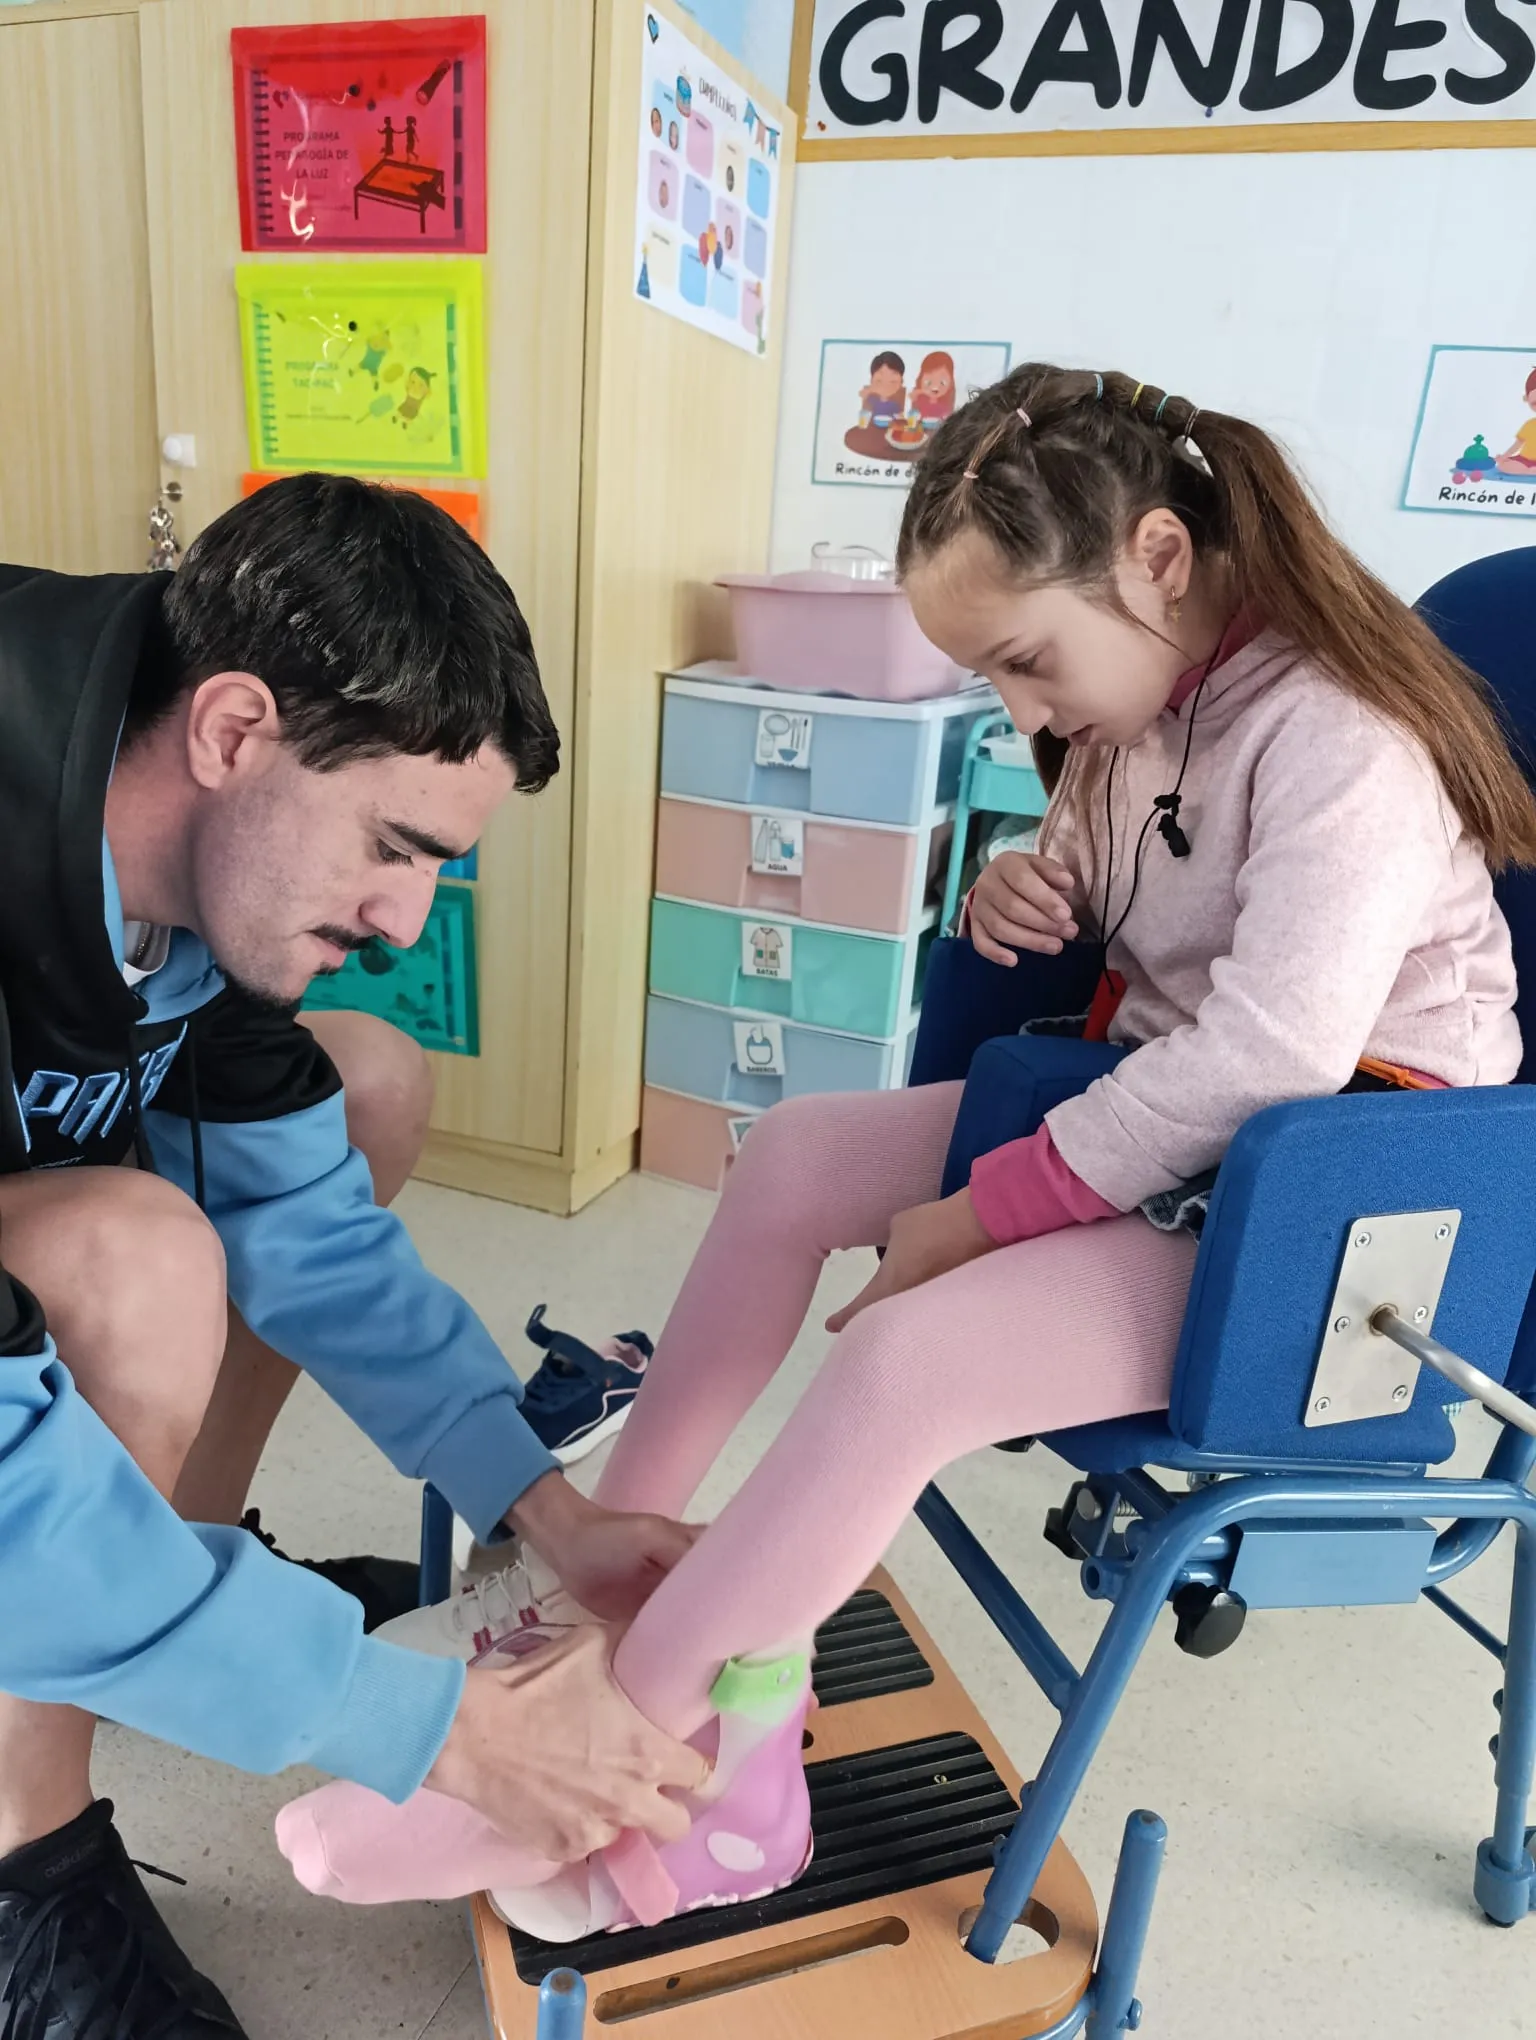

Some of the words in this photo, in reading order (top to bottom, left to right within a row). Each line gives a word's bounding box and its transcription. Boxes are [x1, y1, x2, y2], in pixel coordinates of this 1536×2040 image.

[819, 0, 1536, 126] GRANDES
[335, 149, 350, 161] DE
[296, 168, 308, 179] LA
[835, 462, 880, 476] Rincón
[885, 464, 900, 477] de
[1438, 486, 1498, 505] Rincón
[1505, 490, 1525, 506] de
[768, 863, 788, 872] AGUA
[756, 968, 778, 977] BATAS
